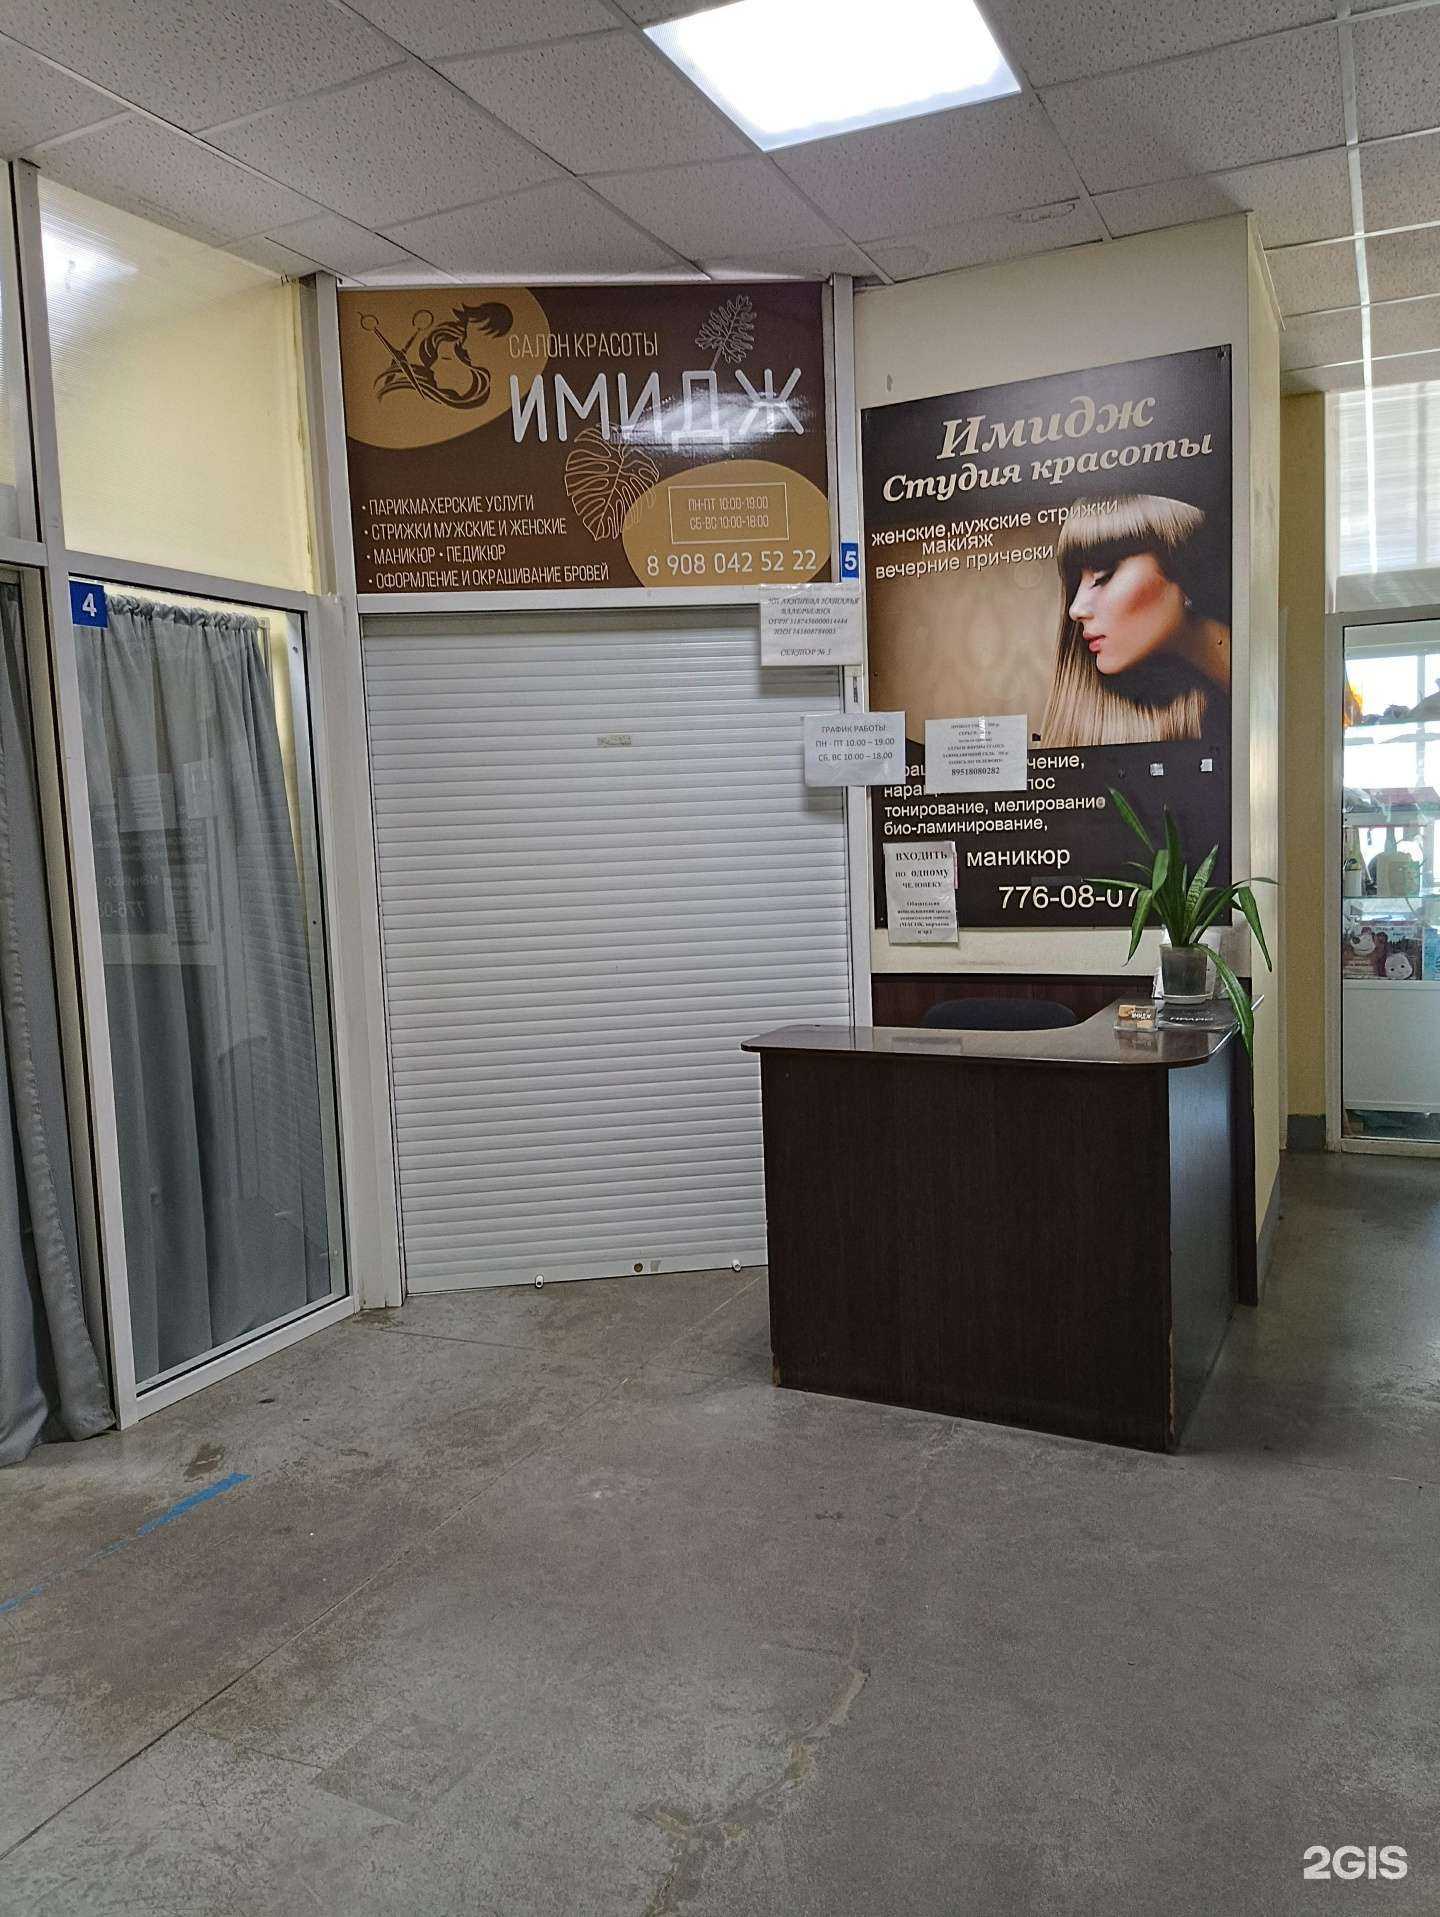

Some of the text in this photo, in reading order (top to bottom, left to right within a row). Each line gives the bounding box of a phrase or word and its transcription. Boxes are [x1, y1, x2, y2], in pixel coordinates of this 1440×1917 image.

[509, 332, 659, 359] САЛОН КРАСОТЫ
[509, 367, 805, 452] ИМИДЖ
[936, 395, 1156, 461] Имидж
[882, 433, 1214, 503] Студия красоты
[369, 494, 535, 517] ПАРИКМАХЕРСКИЕ УСЛУГИ
[1036, 498, 1119, 525] стрижки
[372, 517, 567, 541] СТРИЖКИ МУЖСКИЕ И ЖЕНСКИЕ
[374, 544, 507, 566] МАНИКЮР ПЕДИКЮР
[921, 532, 994, 556] макияж
[647, 549, 817, 577] 8 908 042 52 22
[844, 550, 857, 571] 5
[875, 543, 1055, 581] вечерние прически
[376, 561, 609, 590] ОФОРМЛЕНИЕ И ОКРАШИВАНИЕ БРОВЕЙ
[81, 592, 97, 617] 4
[815, 740, 827, 748] ПН
[951, 767, 1001, 777] 89518080282
[884, 794, 1107, 820] тонирование, мелирование
[883, 817, 1049, 837] био-ламинирование,
[895, 850, 947, 862] ВХОДИТЬ
[966, 847, 1071, 869] маникюр
